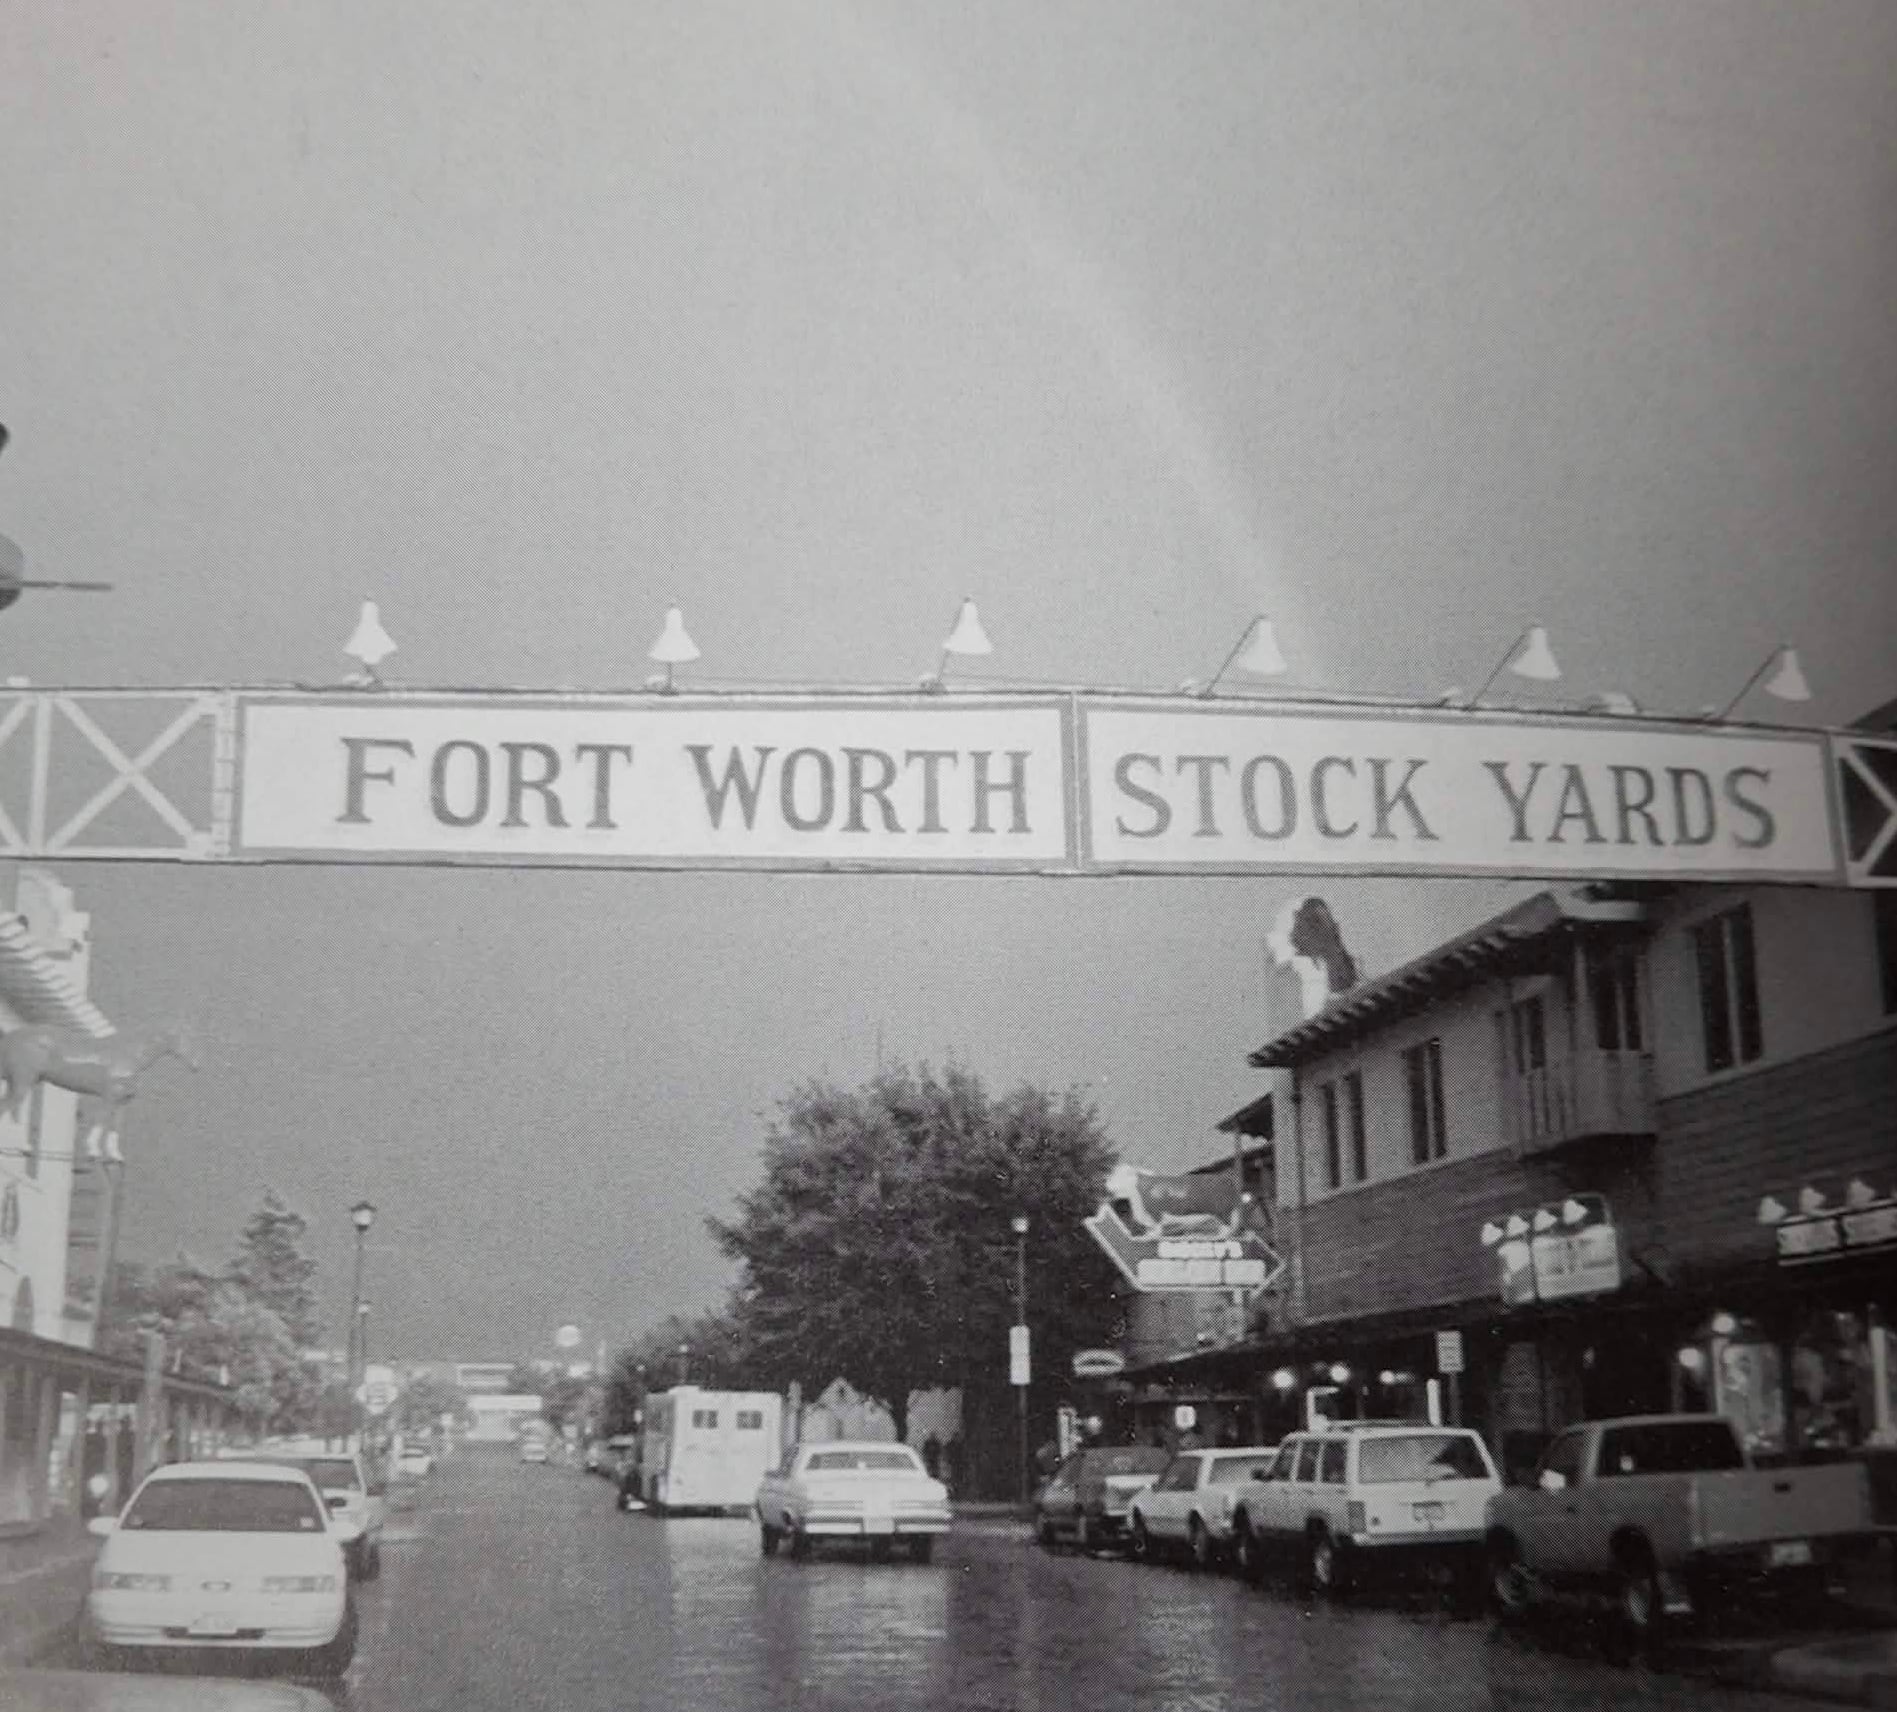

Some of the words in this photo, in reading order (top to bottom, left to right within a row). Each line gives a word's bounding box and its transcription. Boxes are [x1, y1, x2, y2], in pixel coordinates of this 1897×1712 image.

[336, 737, 632, 830] FORT
[685, 744, 1031, 834] WORTH
[1114, 753, 1440, 841] STOCK
[1482, 760, 1777, 851] YARDS
